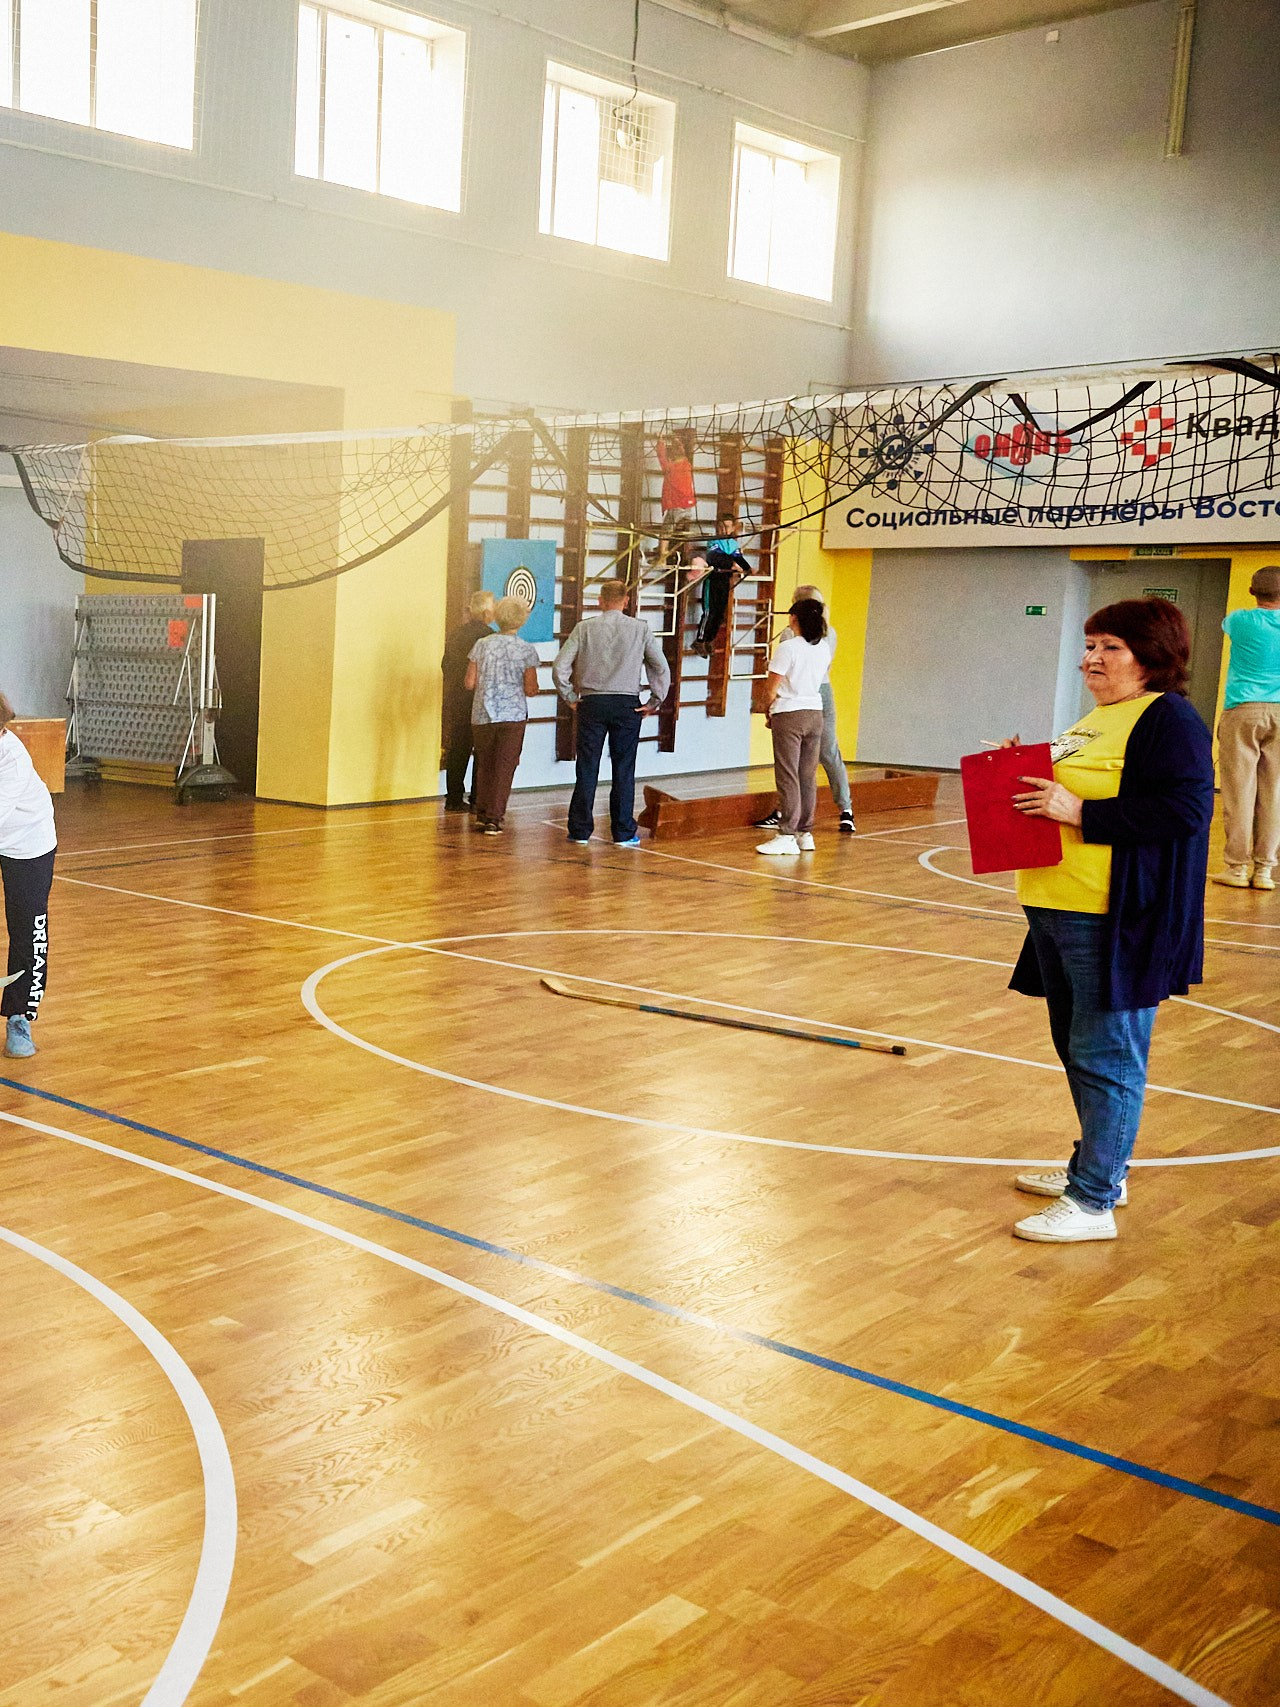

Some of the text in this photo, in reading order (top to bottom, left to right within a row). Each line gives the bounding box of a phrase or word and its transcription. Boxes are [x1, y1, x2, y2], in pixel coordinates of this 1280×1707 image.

[846, 497, 1280, 530] Социальные партнёры Вост
